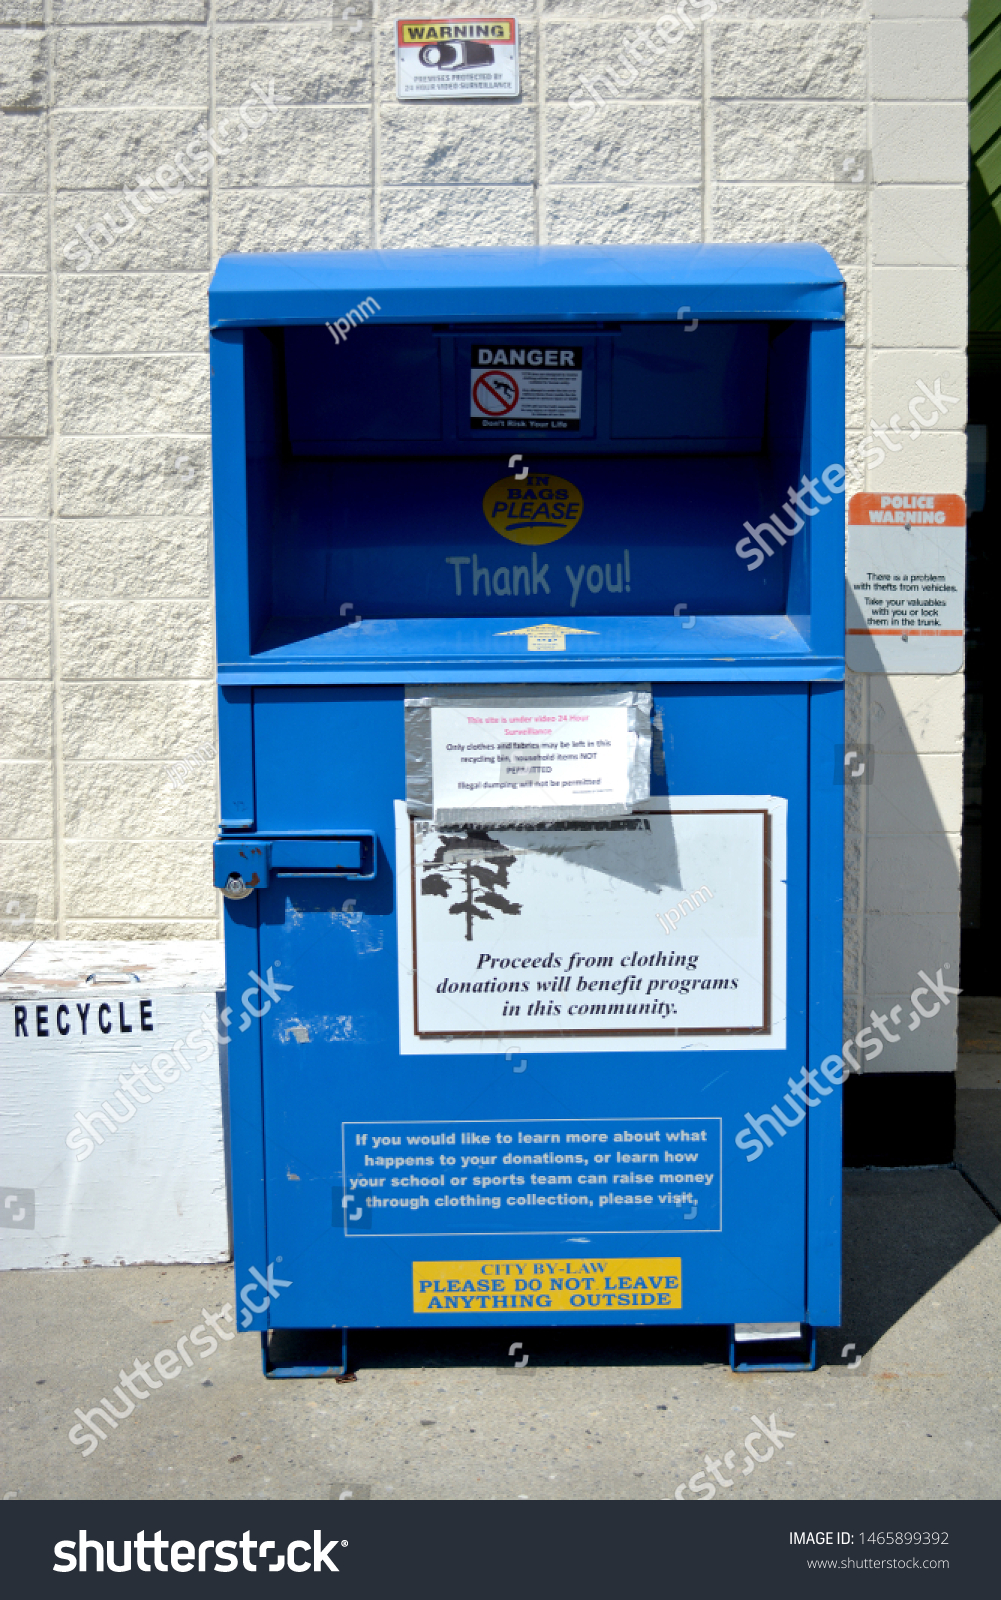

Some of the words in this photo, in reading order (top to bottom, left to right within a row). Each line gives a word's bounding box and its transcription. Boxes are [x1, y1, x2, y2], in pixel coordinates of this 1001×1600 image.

[408, 25, 504, 40] WARNING
[452, 73, 493, 81] PROTECTED
[405, 84, 414, 92] 24
[415, 83, 436, 91] HOUR
[478, 349, 575, 366] DANGER
[526, 477, 549, 486] IN
[507, 489, 569, 500] BAGS
[881, 496, 935, 509] POLICE
[492, 502, 580, 520] PLEASE
[869, 510, 946, 524] WARNING
[446, 552, 550, 597] Thank
[565, 549, 631, 608] you!
[866, 573, 890, 581] There
[910, 574, 946, 583] problem
[853, 582, 871, 590] with
[873, 583, 898, 591] thefts
[899, 583, 919, 591] from
[921, 583, 957, 592] vehicles.
[864, 597, 883, 605] Take
[885, 599, 905, 607] your
[907, 598, 947, 606] valuables
[871, 607, 889, 615] with
[891, 609, 907, 617] you
[921, 608, 939, 616] lock
[891, 618, 900, 626] in
[901, 618, 915, 626] the
[918, 618, 942, 626] trunk.
[509, 715, 532, 723] under
[446, 743, 465, 752] Only
[466, 742, 495, 751] clothes
[513, 741, 540, 749] fabrics
[541, 742, 558, 750] may
[560, 740, 570, 748] be
[572, 740, 586, 748] left
[587, 740, 595, 748] in
[596, 740, 612, 748] this
[461, 755, 495, 764] recycling
[557, 753, 579, 761] items
[579, 752, 597, 760] NOT
[458, 782, 482, 791] Illegal
[483, 781, 518, 790] dumping
[519, 780, 533, 788] will
[549, 779, 560, 787] be
[561, 778, 602, 788] permitted
[476, 952, 563, 970] Proceeds
[564, 951, 614, 972] from
[620, 950, 699, 971] clothing
[436, 977, 530, 994] donations
[536, 976, 571, 992] will
[576, 975, 643, 995] benefit
[645, 977, 739, 995] programs
[502, 1001, 521, 1016] in
[527, 1000, 562, 1016] this
[567, 999, 678, 1018] community.
[14, 1000, 154, 1037] RECYCLE
[355, 1133, 368, 1146] If
[372, 1136, 401, 1149] you
[406, 1132, 456, 1146] would
[461, 1132, 491, 1145] like
[495, 1132, 513, 1144] to
[518, 1131, 561, 1144] learn
[566, 1132, 609, 1143] more
[613, 1130, 661, 1143] about
[665, 1129, 708, 1142] what
[364, 1154, 434, 1169] happens
[439, 1154, 457, 1165] to
[461, 1155, 498, 1168] your
[502, 1152, 589, 1166] donations,
[594, 1153, 611, 1163] or
[616, 1151, 659, 1163] learn
[664, 1150, 699, 1162] how
[349, 1177, 386, 1190] your
[391, 1174, 445, 1187] school
[450, 1176, 468, 1187] or
[473, 1174, 525, 1189] sports
[530, 1173, 572, 1185] team
[577, 1173, 608, 1185] can
[612, 1171, 654, 1184] raise
[659, 1173, 714, 1186] money
[366, 1195, 430, 1210] through
[434, 1194, 501, 1209] clothing
[506, 1193, 594, 1207] collection,
[599, 1192, 654, 1207] please
[658, 1191, 699, 1206] visit,
[480, 1263, 528, 1276] CITY
[533, 1262, 609, 1275] BY-LAW
[419, 1279, 505, 1293] PLEASE
[514, 1278, 543, 1292] DO
[549, 1277, 596, 1291] NOT
[604, 1275, 679, 1290] LEAVE
[427, 1294, 553, 1309] ANYTHING
[569, 1292, 671, 1307] OUTSIDE
